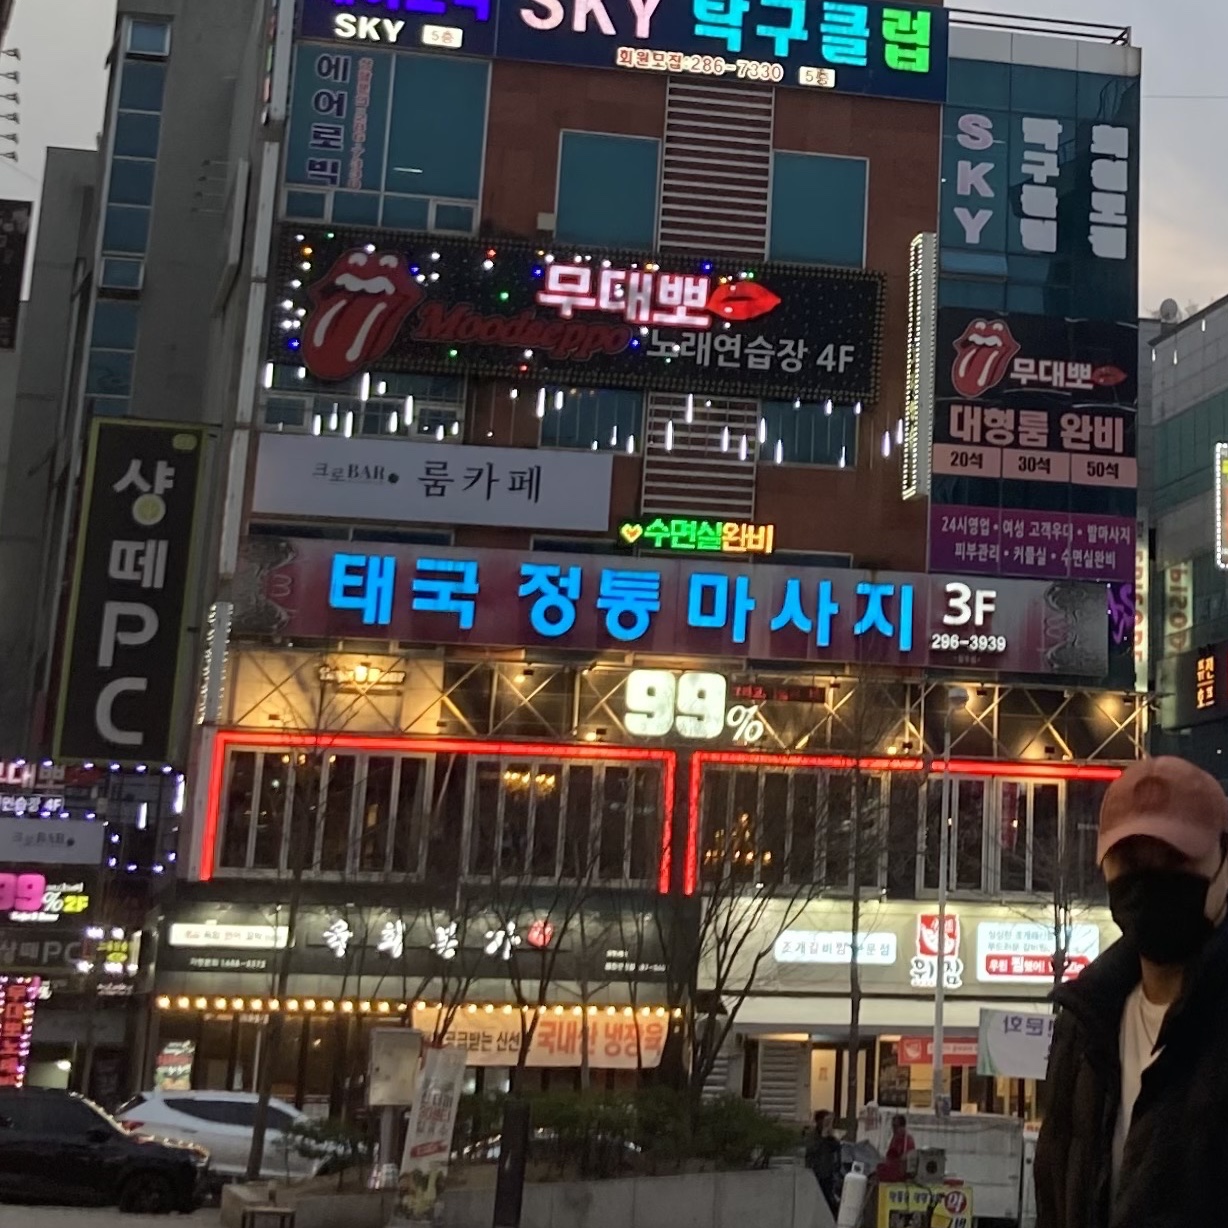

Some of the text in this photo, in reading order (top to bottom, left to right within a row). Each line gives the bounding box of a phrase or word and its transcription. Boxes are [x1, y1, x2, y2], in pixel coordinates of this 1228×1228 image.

[335, 13, 405, 43] SKY
[431, 29, 455, 44] 5층
[520, 0, 932, 73] SKY 탁구클럽
[804, 69, 833, 86] 5층
[954, 112, 995, 244] SKY
[538, 262, 712, 327] 무대뽀
[646, 329, 857, 375] 노래연습장 4F
[1010, 357, 1094, 390] 무대뽀
[949, 403, 1124, 453] 대형룸 완비
[950, 450, 984, 470] 20석
[1017, 455, 1051, 475] 30석
[1086, 460, 1120, 480] 50석
[417, 460, 543, 504] 룸카페
[645, 517, 775, 555] 수면실완비
[941, 515, 991, 537] 24시영업
[1003, 518, 1025, 539] 여성
[1086, 523, 1131, 546] 발마사지
[954, 541, 1000, 563] 피부관리
[1061, 548, 1117, 570] 수면실완비
[329, 552, 913, 653] 태국 정통 마사지
[942, 581, 997, 627] 3F
[625, 669, 764, 743] 99%
[0, 761, 66, 790] 대뽀
[61, 894, 90, 914] 2F
